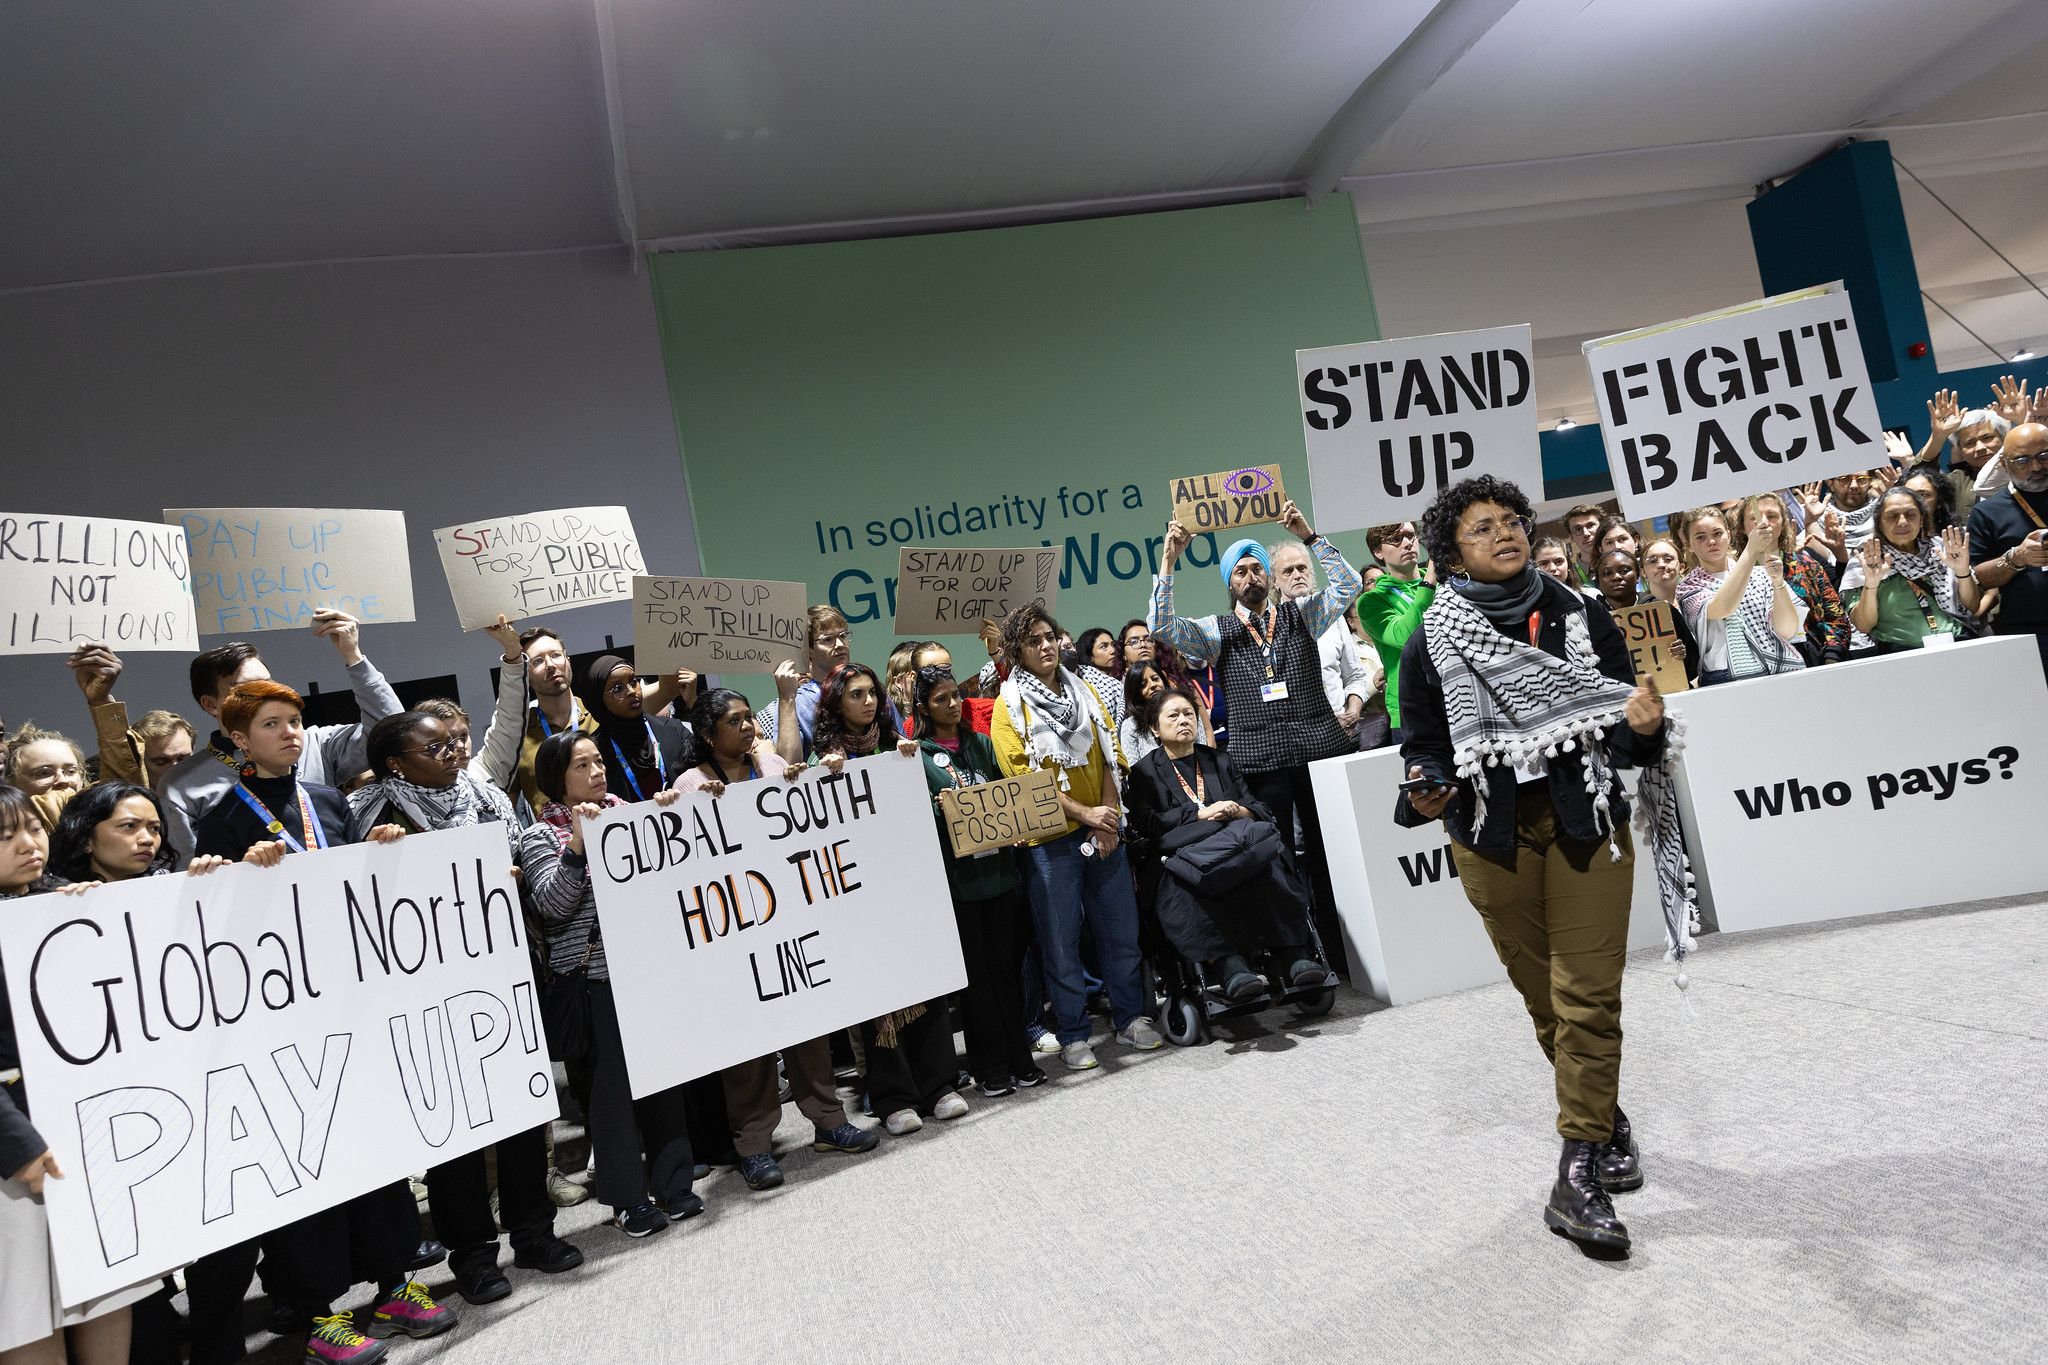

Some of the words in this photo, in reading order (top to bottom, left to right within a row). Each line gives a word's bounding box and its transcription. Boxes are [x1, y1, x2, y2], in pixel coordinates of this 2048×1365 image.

[1304, 349, 1530, 430] STAND
[1602, 319, 1848, 427] FIGHT
[1378, 429, 1475, 498] UP
[1620, 387, 1872, 496] BACK
[1175, 475, 1219, 504] ALL
[1194, 500, 1229, 527] ON
[1232, 491, 1281, 524] YOU
[180, 512, 261, 559] PAY
[288, 519, 343, 555] UP
[453, 520, 542, 556] STAND
[815, 520, 854, 555] In
[865, 495, 1047, 547] solidarity
[1056, 485, 1111, 518] for
[1121, 484, 1143, 511] a
[0, 518, 187, 581] RILLIONS
[543, 541, 639, 574] PUBLIC
[906, 552, 985, 573] STAND
[999, 554, 1025, 575] UP
[1041, 521, 1220, 590] Word
[51, 574, 117, 607] NOT
[188, 561, 337, 609] PUBLIC
[518, 571, 628, 608] FINANCE
[649, 581, 733, 602] STAND
[741, 585, 770, 606] UP
[917, 575, 959, 592] FOR
[972, 576, 1012, 593] OUR
[10, 610, 177, 647] ILLIONS
[643, 603, 693, 626] FOR
[704, 606, 804, 643] TRILLIONS
[935, 596, 1009, 622] RIGHTS
[667, 630, 709, 649] NOT
[708, 641, 772, 664] BILLIONS
[956, 781, 1021, 817] STOP
[1031, 775, 1063, 830] FUEL
[1735, 777, 1852, 820] Who
[1868, 745, 2020, 811] pays?
[600, 799, 743, 884] GLOBAL
[756, 768, 877, 841] SOUTH
[952, 808, 1040, 850] FOSSIL
[677, 869, 778, 950] HOLD
[785, 838, 862, 906] THE
[29, 883, 321, 1066] Global
[344, 858, 520, 982] North
[749, 930, 832, 1002] LINE
[75, 1031, 352, 1268] PAY
[388, 981, 549, 1148] UP!
